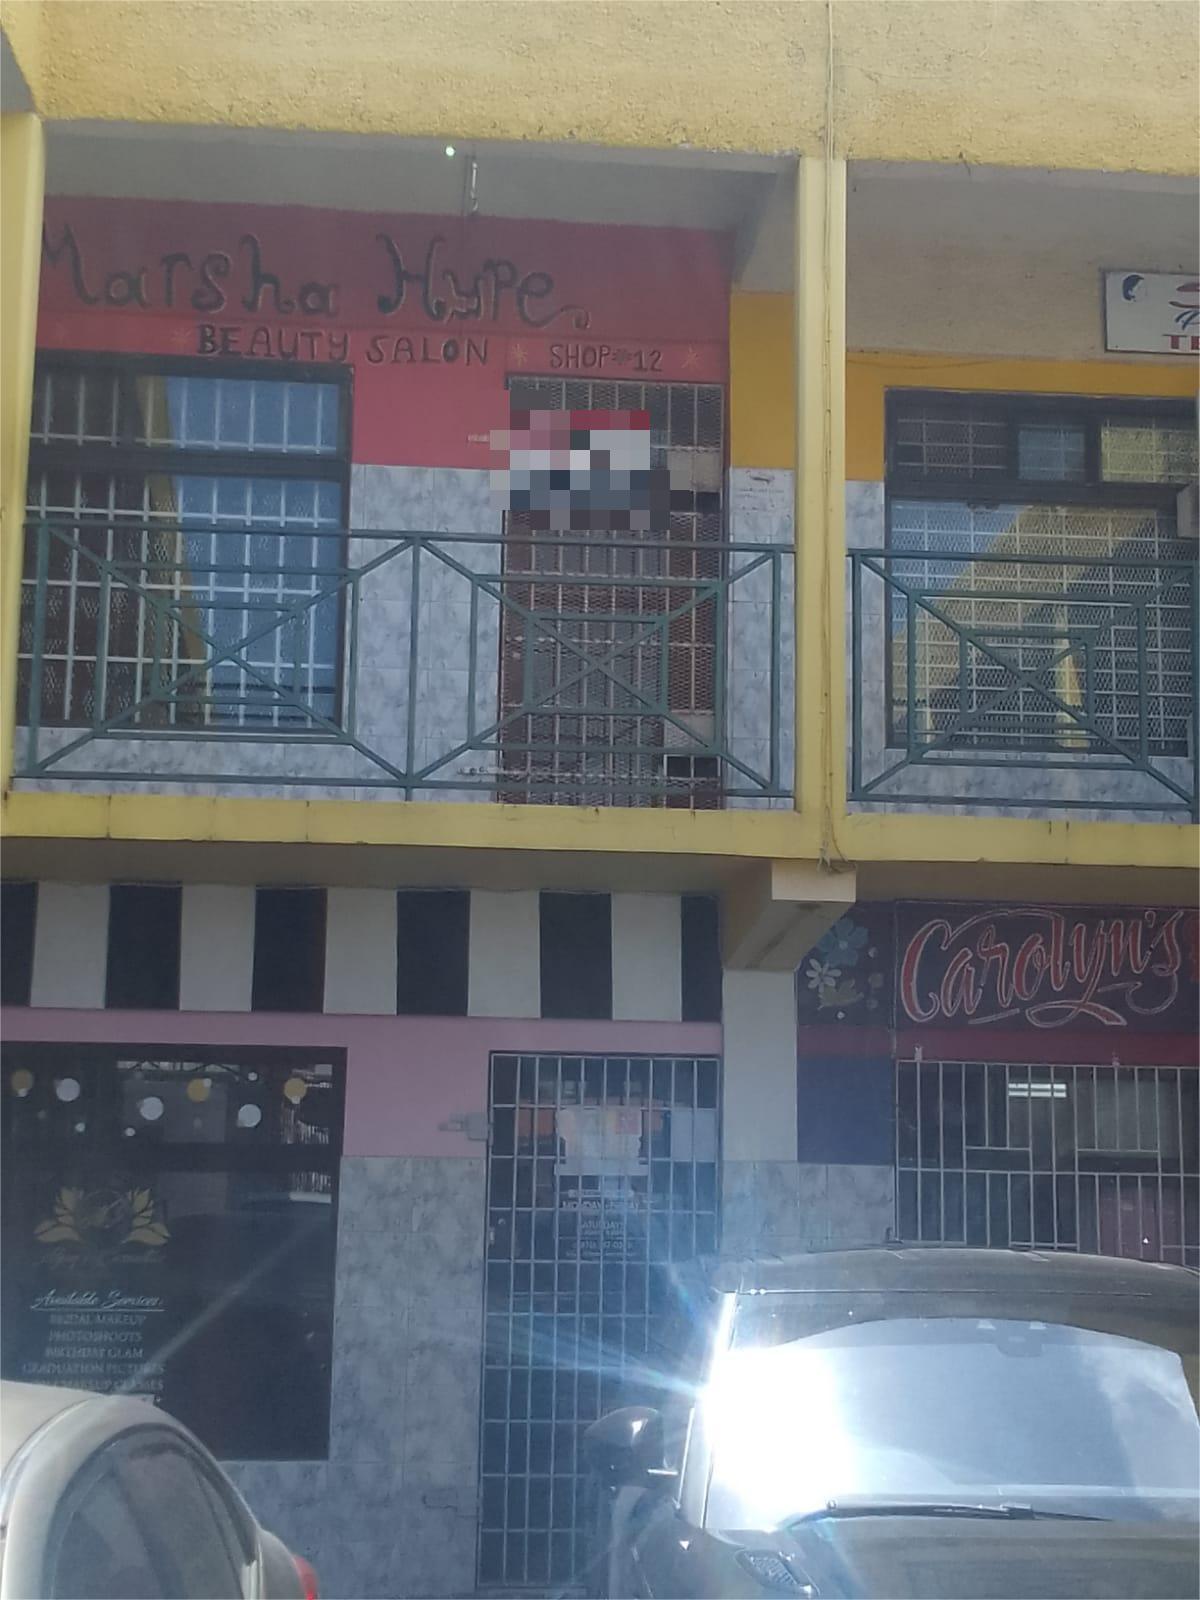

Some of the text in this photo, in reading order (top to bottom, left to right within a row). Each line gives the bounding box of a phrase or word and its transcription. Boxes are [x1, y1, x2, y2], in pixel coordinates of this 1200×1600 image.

[42, 222, 590, 329] Marsha Hype
[196, 324, 349, 365] BEAUTY
[366, 334, 489, 366] SALON
[901, 907, 1184, 1028] Carolyn's
